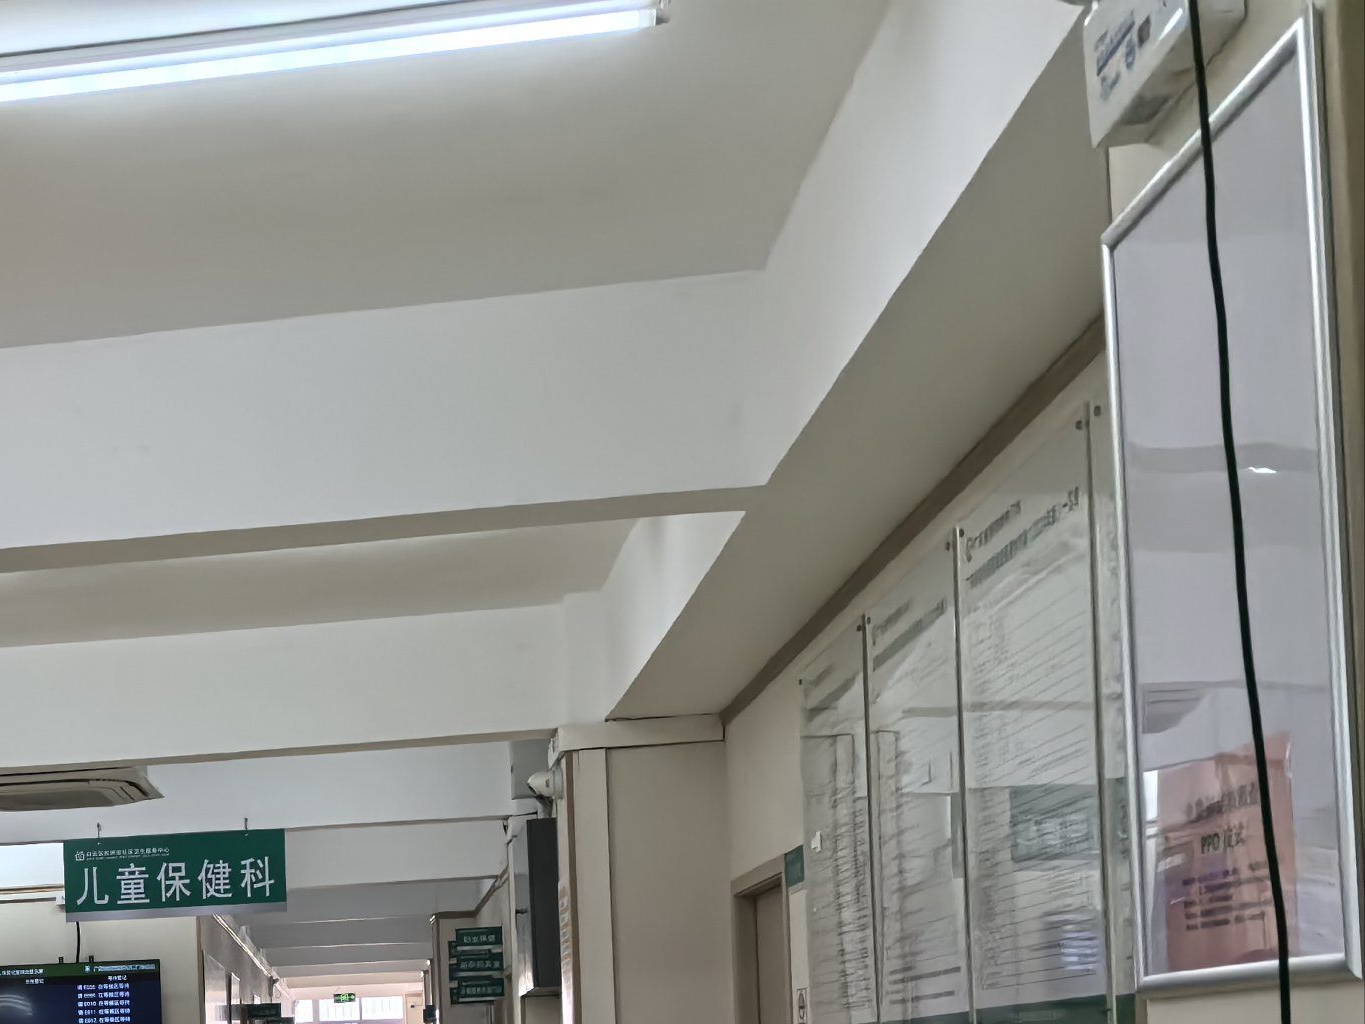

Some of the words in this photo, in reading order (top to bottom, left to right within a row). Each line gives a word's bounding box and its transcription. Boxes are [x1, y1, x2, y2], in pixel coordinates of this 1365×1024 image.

[76, 856, 275, 905] 儿童保健科
